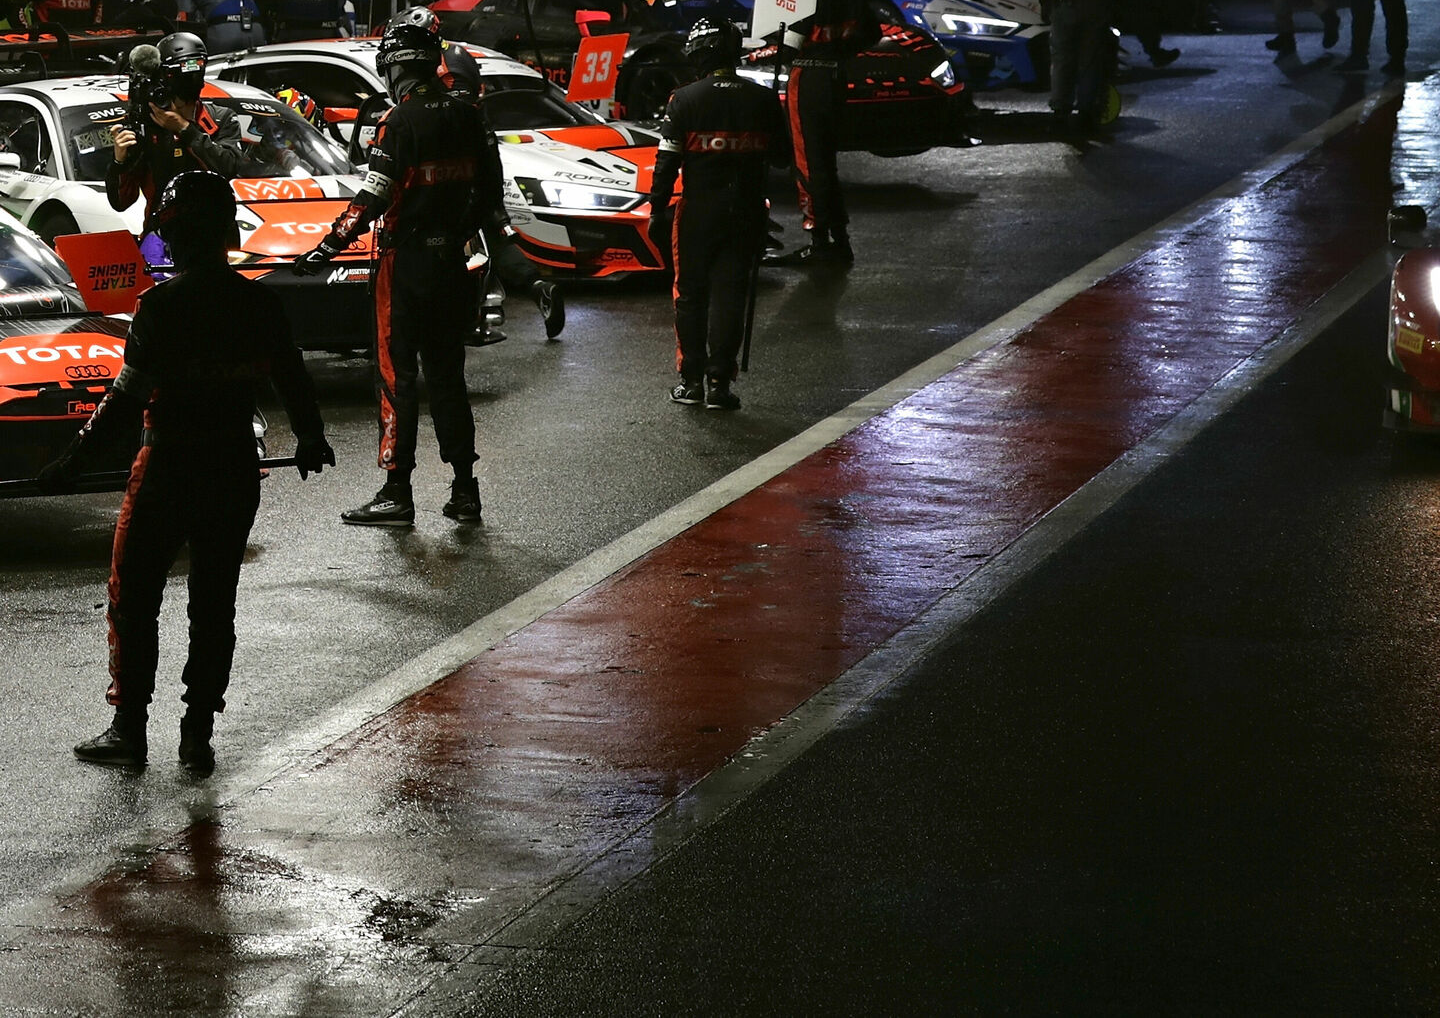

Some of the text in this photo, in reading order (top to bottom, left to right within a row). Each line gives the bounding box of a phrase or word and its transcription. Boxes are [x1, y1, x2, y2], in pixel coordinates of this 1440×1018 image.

[582, 50, 612, 85] 33
[88, 107, 127, 121] aws
[240, 101, 276, 113] aws
[87, 262, 138, 280] ENGINE
[92, 276, 137, 292] START
[74, 402, 97, 412] R8
